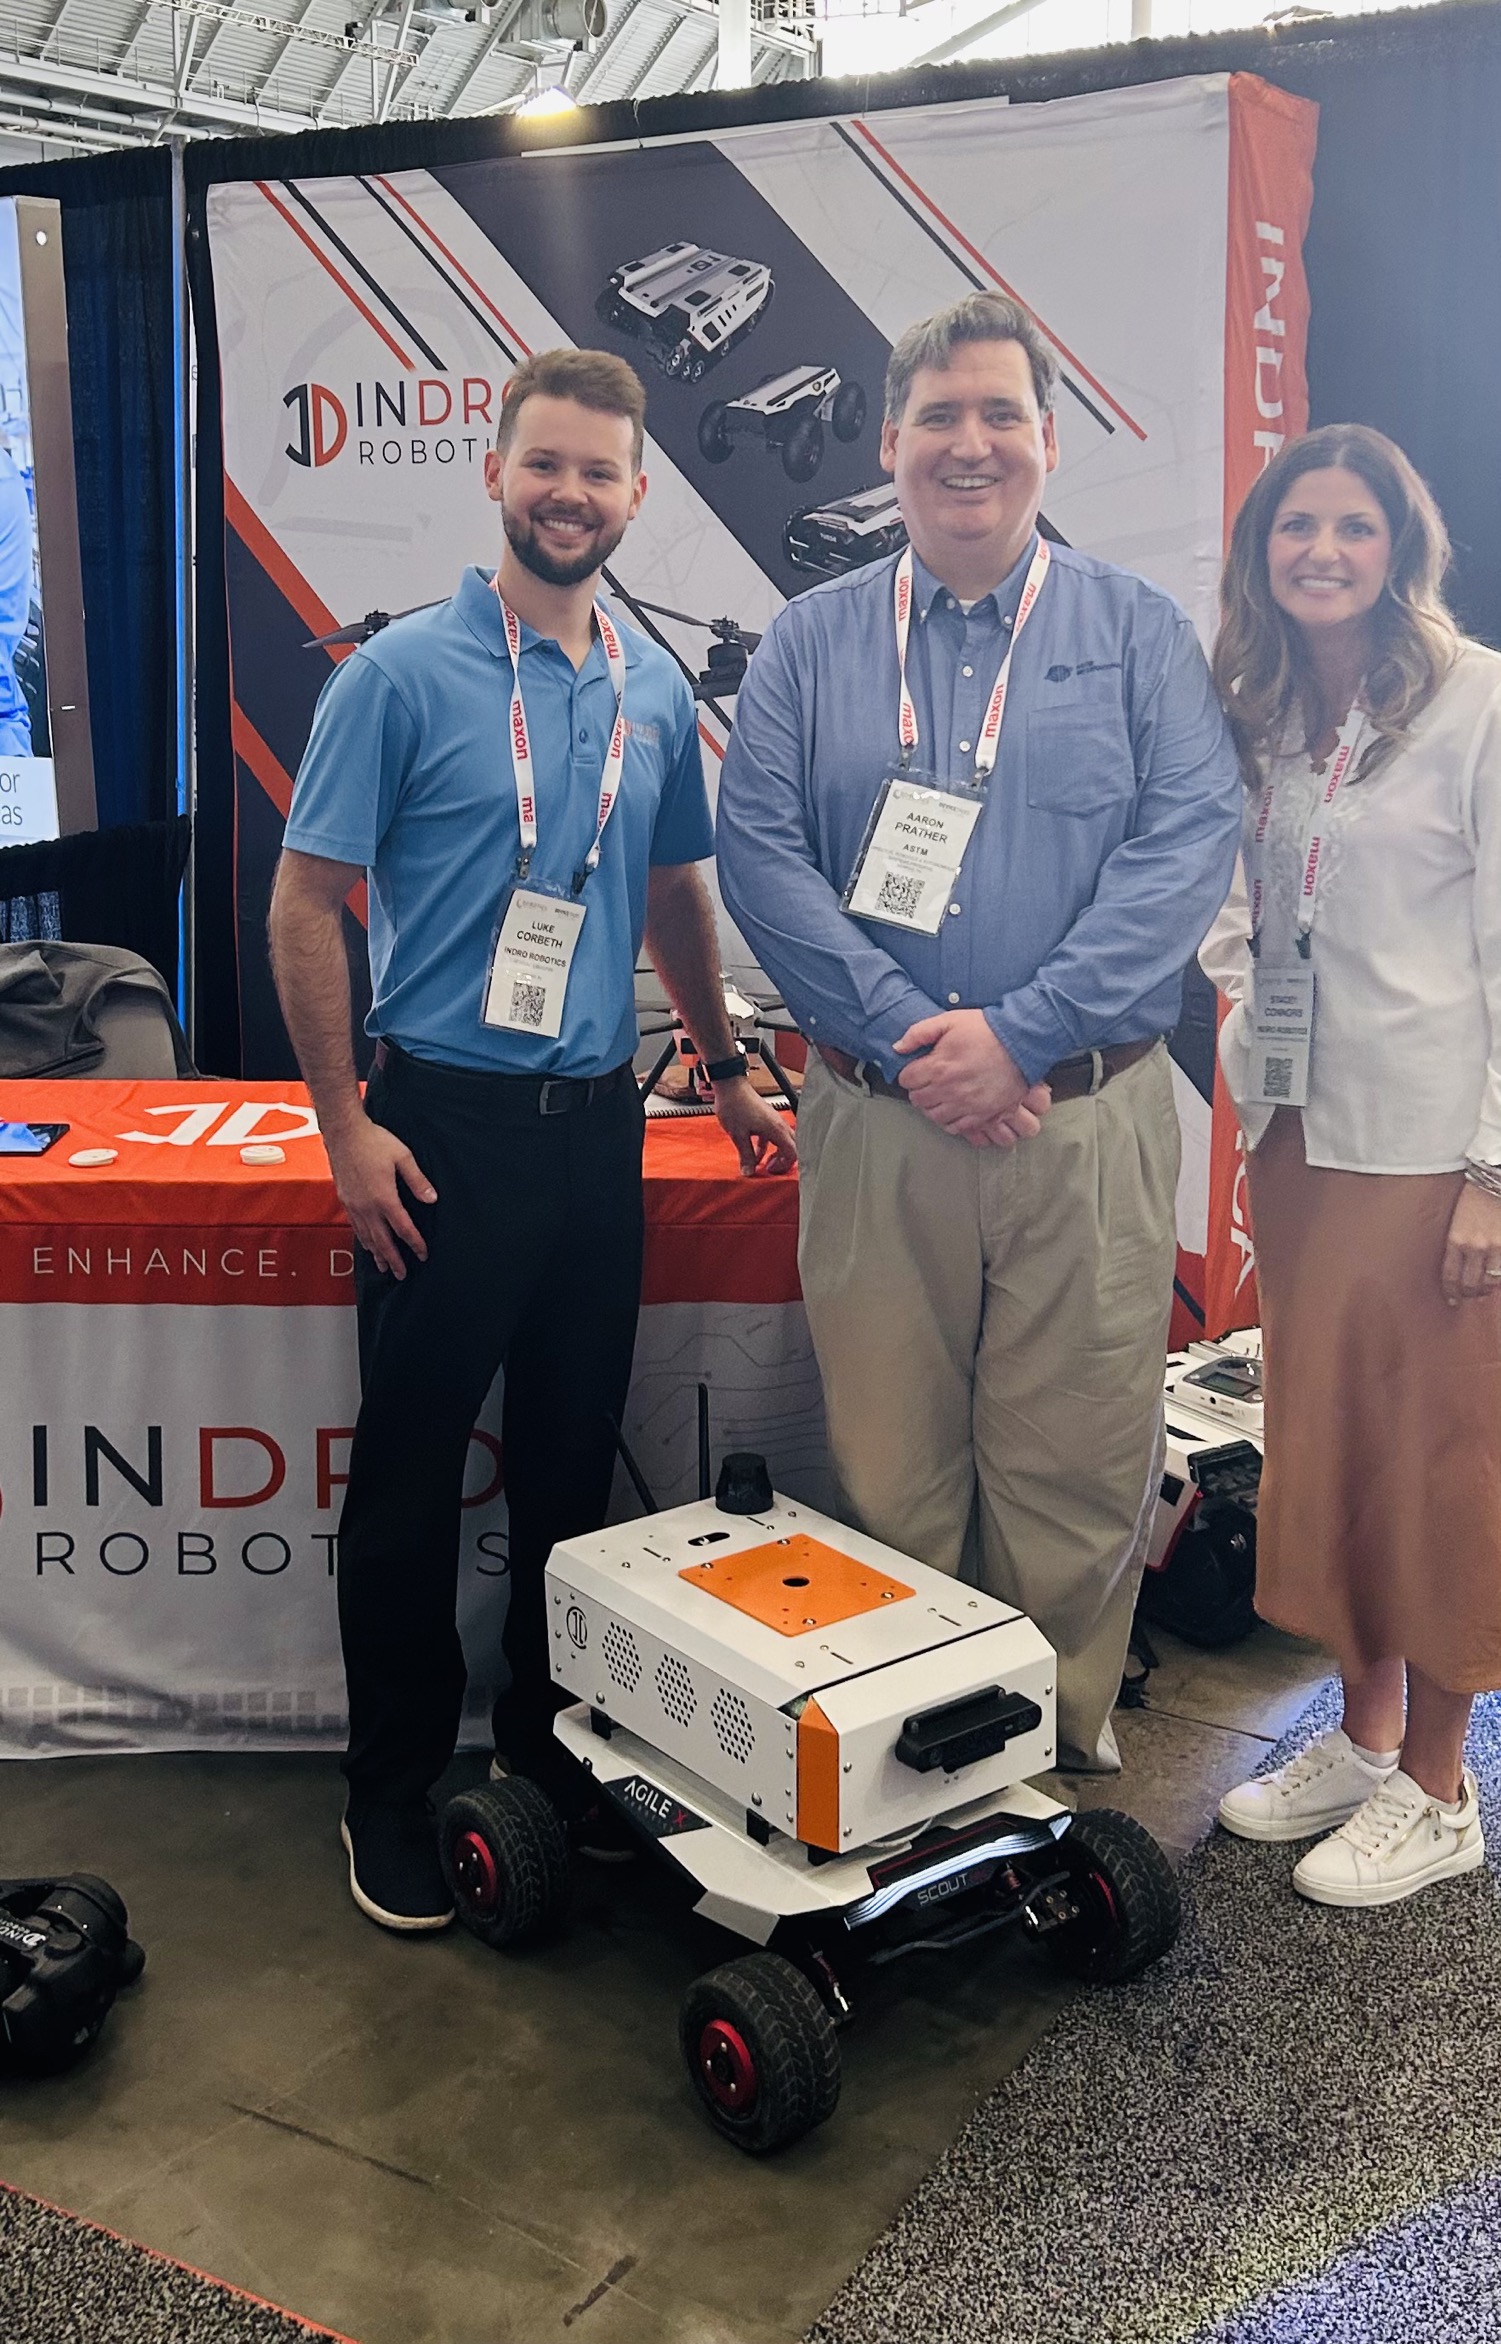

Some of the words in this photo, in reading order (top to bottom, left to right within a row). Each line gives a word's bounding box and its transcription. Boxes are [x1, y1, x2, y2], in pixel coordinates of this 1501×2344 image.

[356, 377, 514, 427] INDR
[898, 576, 909, 621] maxon
[502, 602, 519, 656] maxo
[597, 607, 620, 659] maxo
[512, 700, 529, 761] maxon
[985, 683, 1005, 738] maxon
[1323, 745, 1351, 804] maxon
[894, 822, 949, 844] PRATHER
[907, 812, 945, 829] AARON
[903, 844, 929, 856] ASTM
[1303, 836, 1321, 896] maxon
[516, 930, 564, 949] CORBETH
[532, 921, 556, 934] LUKE
[529, 951, 567, 968] ROBOTICS
[33, 1246, 297, 1278] ENHANCE.
[36, 1532, 511, 1577] ROBOTS
[917, 1873, 969, 1907] SCOUT
